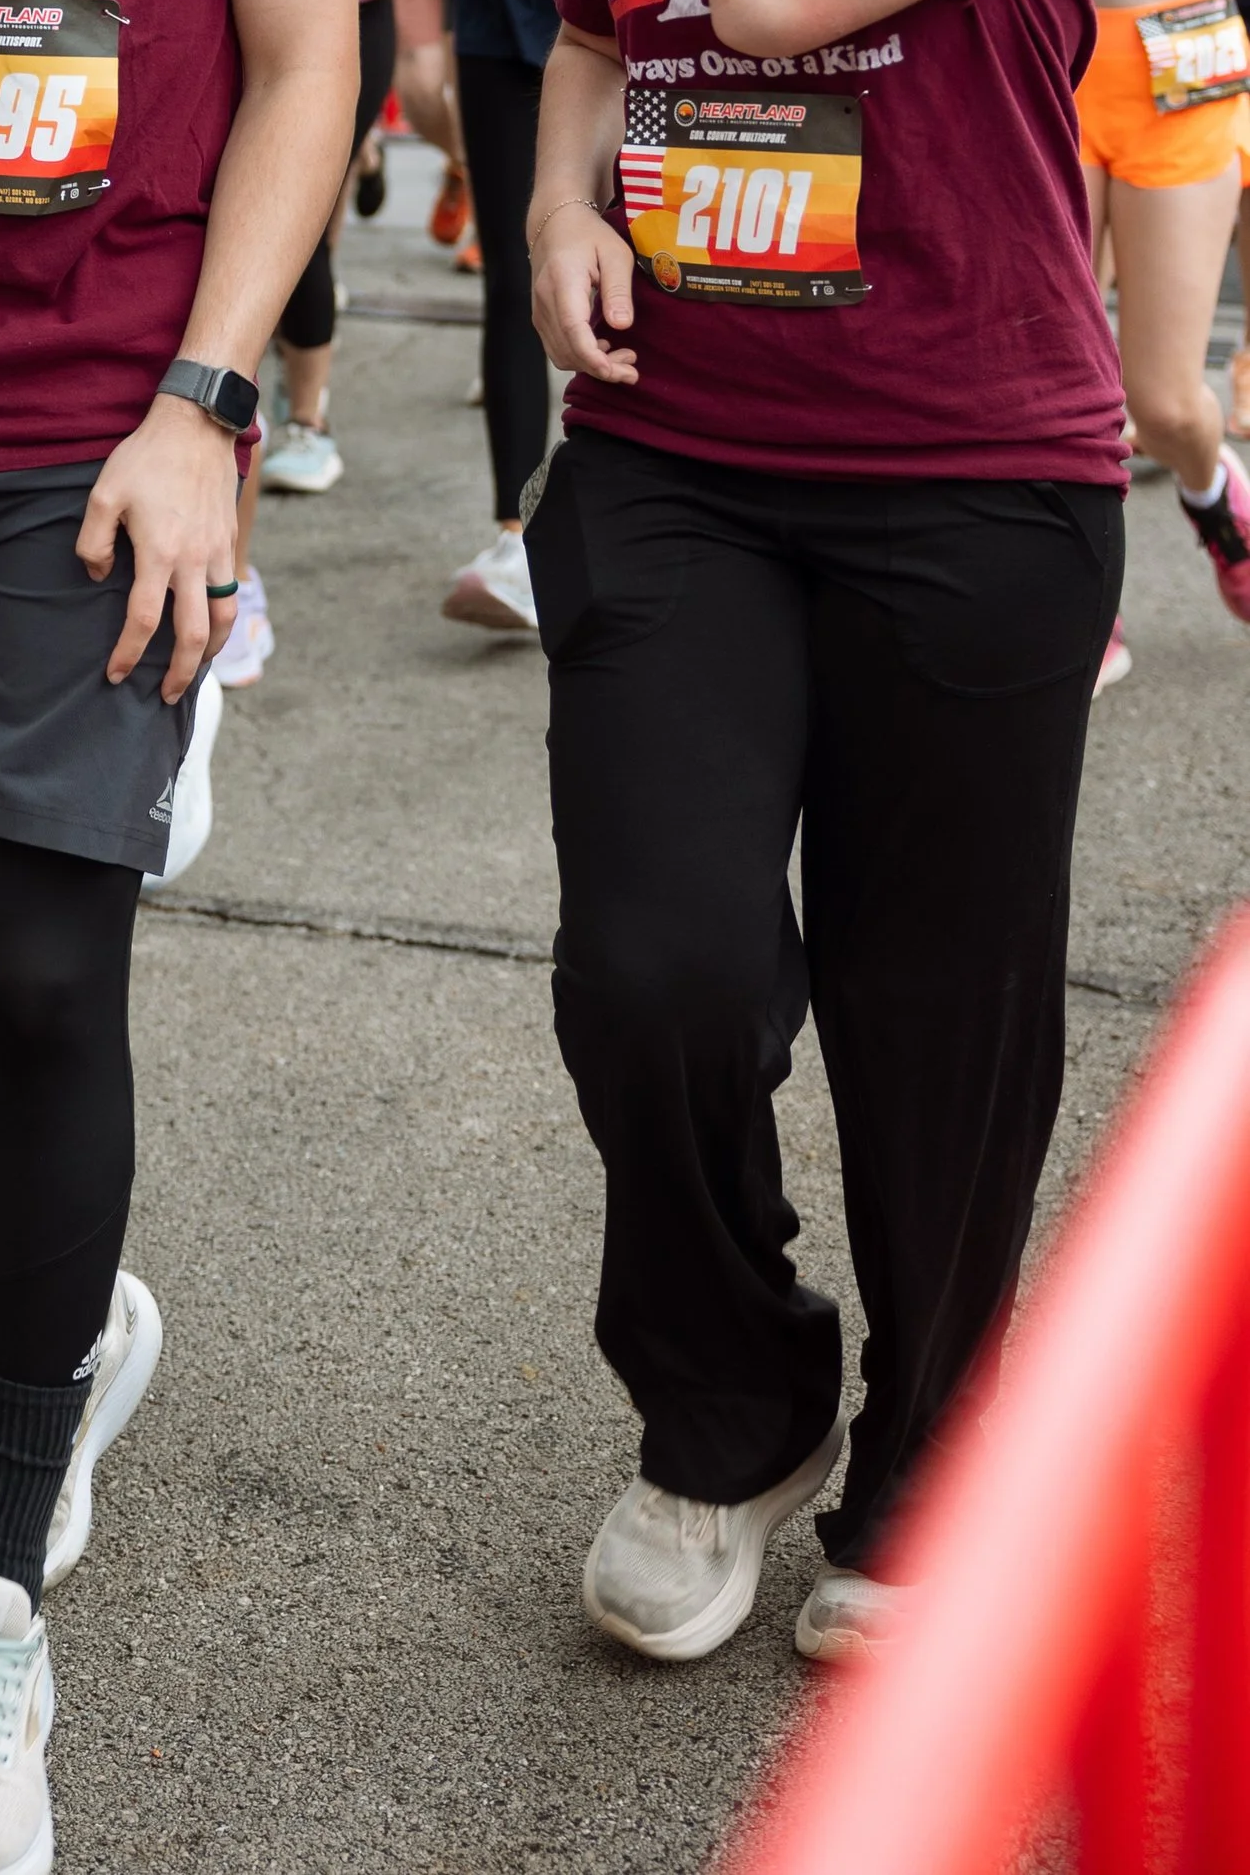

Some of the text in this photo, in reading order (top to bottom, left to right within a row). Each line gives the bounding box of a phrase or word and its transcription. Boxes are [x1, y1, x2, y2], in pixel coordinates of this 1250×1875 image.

[700, 49, 758, 76] One
[761, 55, 798, 77] of
[802, 55, 819, 74] a
[819, 33, 904, 74] Kind
[699, 102, 807, 122] HEARTLAND
[706, 130, 738, 142] COUNTRY.
[739, 132, 787, 144] MULTISPORT.
[675, 165, 813, 255] 2101
[148, 807, 172, 824] Reebo
